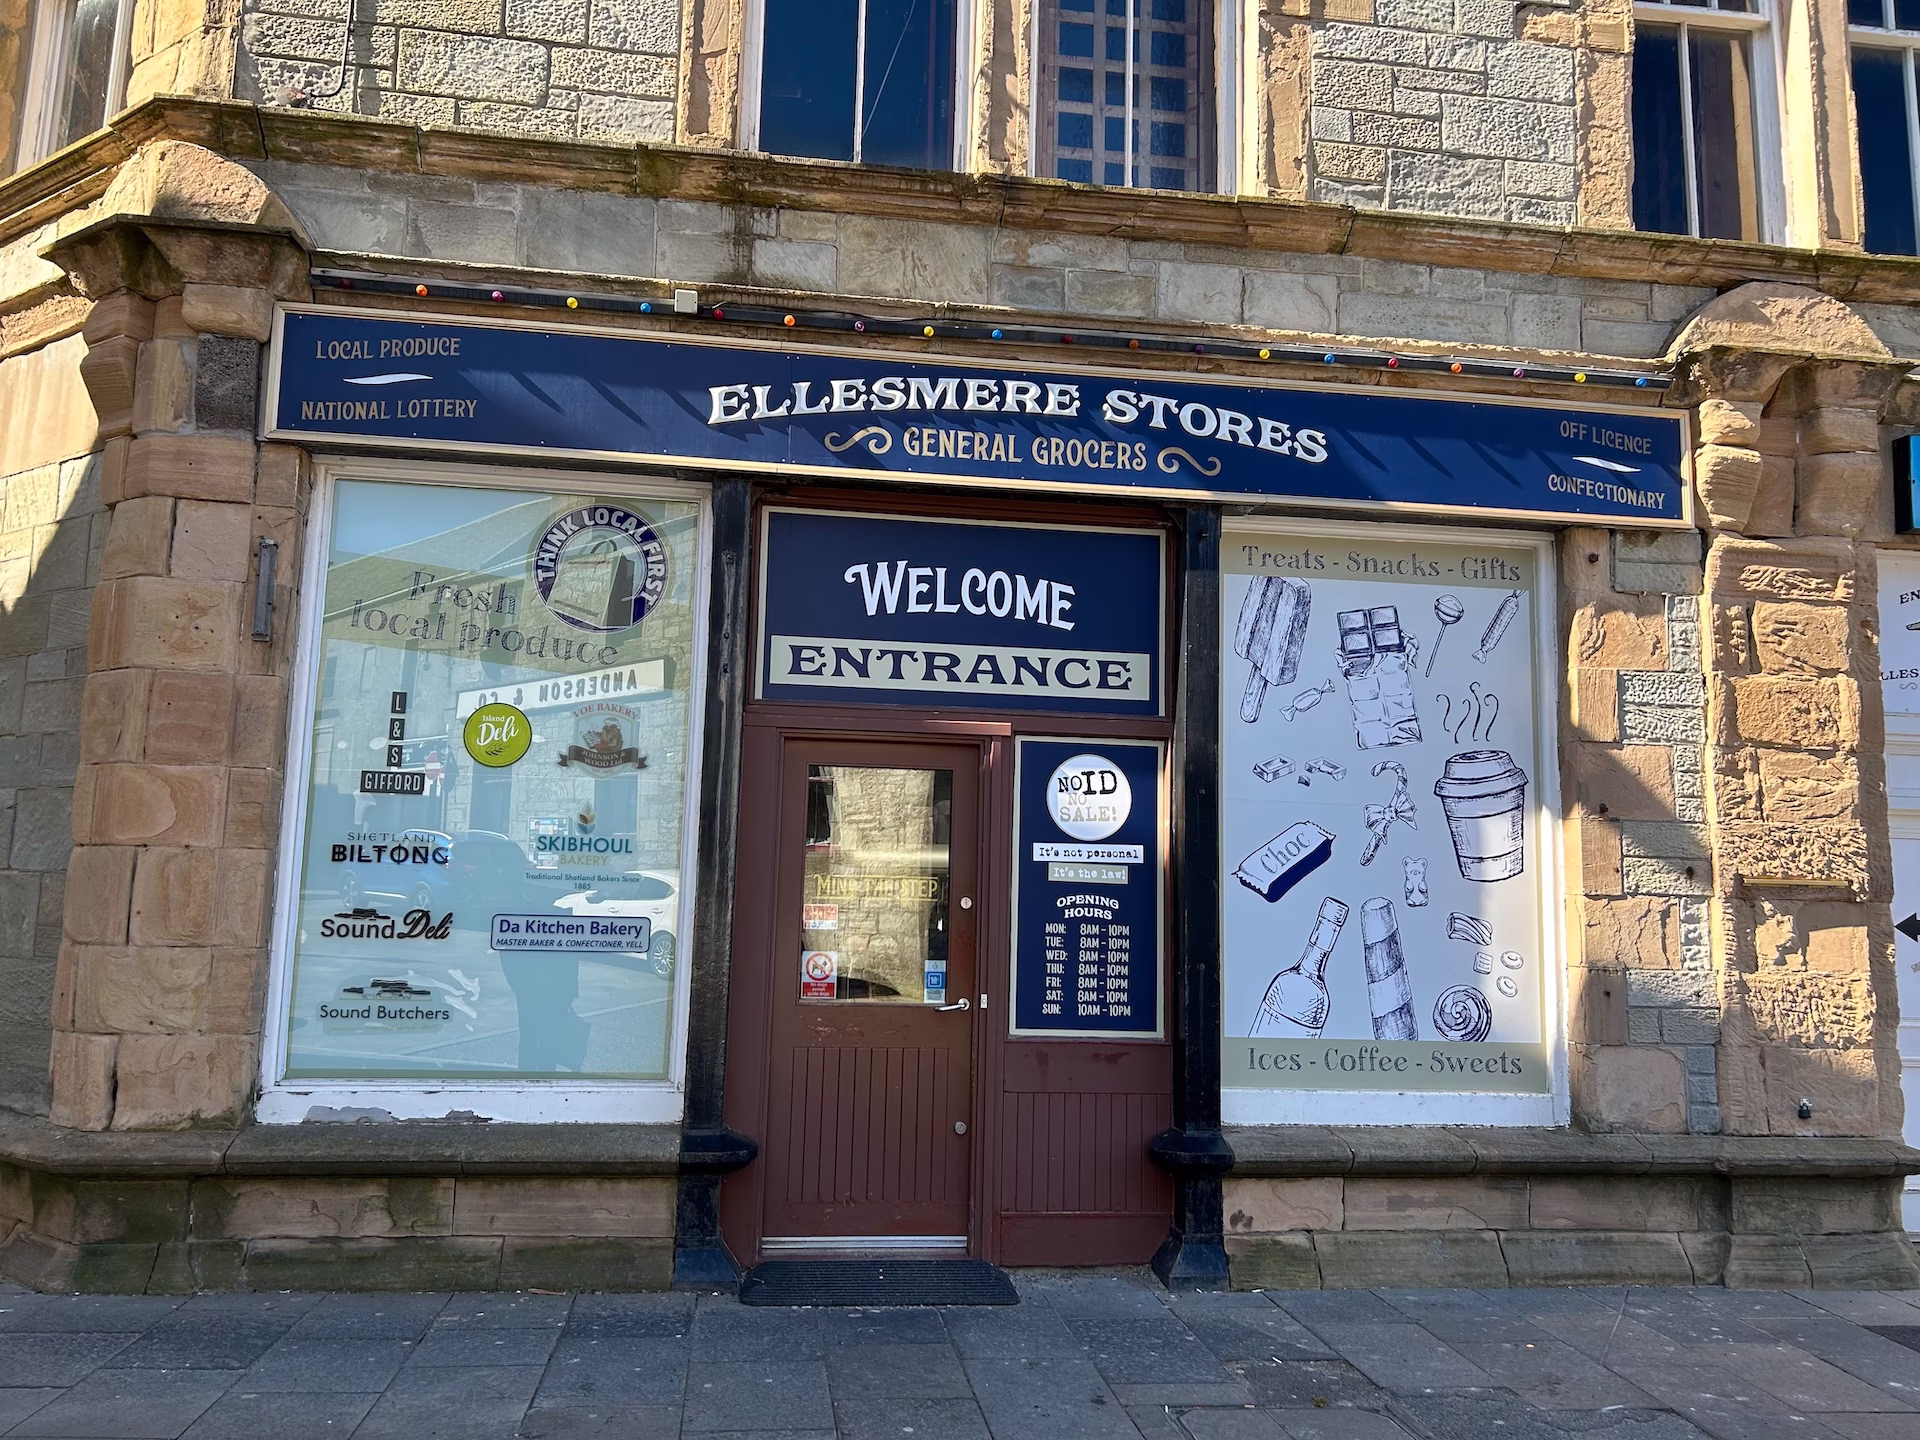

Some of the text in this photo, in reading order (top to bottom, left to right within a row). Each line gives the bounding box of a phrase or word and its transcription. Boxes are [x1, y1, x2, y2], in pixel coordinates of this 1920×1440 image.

[316, 336, 461, 360] LOCAL PRODUCE
[301, 399, 478, 420] NATIONAL LOTTERY
[707, 376, 1330, 465] ELLESMERE STORES
[1560, 420, 1652, 455] OFF LICENCE
[903, 427, 1148, 473] GENERAL GROCERS
[1548, 474, 1665, 510] CONFECTIONARY
[537, 508, 666, 607] THINK LOCAL FIRST
[1242, 545, 1325, 571] Treats
[1346, 550, 1440, 576] Snacks
[1460, 556, 1521, 582] Gifts
[408, 571, 515, 615] Fresh
[844, 560, 1076, 632] WELCOME
[350, 599, 619, 665] local produce
[787, 644, 1133, 691] ENTRANCE
[482, 714, 505, 722] Island
[574, 703, 638, 720] VOE BAKERY
[476, 716, 519, 746] Deli
[582, 750, 619, 761] JOHNSON
[584, 758, 609, 767] WOOD
[364, 772, 421, 792] GIFFORD
[1058, 770, 1118, 795] NO ID
[1068, 793, 1087, 806] NO
[1060, 806, 1117, 822] SALE!
[348, 831, 436, 843] SHETLAND
[536, 836, 633, 854] SKIBHOUL
[560, 854, 610, 866] BAKERY
[1039, 847, 1139, 859] It's not personal
[1260, 832, 1311, 874] Choc
[525, 872, 640, 884] Traditional Shetland Bakers Since
[1054, 867, 1126, 880] It's the law!
[574, 882, 592, 890] 1885
[900, 879, 938, 898] STEP
[1056, 894, 1120, 910] OPENING
[1064, 908, 1113, 920] HOURS
[320, 909, 454, 940] Sound Deli
[499, 920, 643, 938] Da Kitchen Bakery
[1045, 923, 1066, 934] MON:
[1080, 924, 1099, 935] 8AM
[1108, 925, 1129, 936] 10PM
[496, 938, 528, 946] MASTER
[530, 938, 554, 946] BAKER
[566, 939, 624, 948] CONFECTIONER,
[626, 940, 643, 948] YELL
[1045, 936, 1064, 947] TUE:
[1080, 937, 1099, 948] 8AM
[1108, 938, 1129, 949] 10PM
[1046, 950, 1068, 960] WED:
[1079, 950, 1098, 962] 8AM
[1108, 951, 1129, 963] 10PM
[1046, 963, 1064, 974] THU:
[1079, 964, 1098, 975] 8AM
[1107, 965, 1128, 976] 10PM
[1046, 977, 1061, 987] FRI:
[1078, 977, 1097, 988] 8AM
[1107, 978, 1128, 989] 10PM
[1046, 990, 1064, 1001] SAT:
[1078, 991, 1097, 1002] 8AM
[1106, 991, 1127, 1003] 10PM
[320, 1005, 450, 1020] Sound Butchers
[1042, 1003, 1061, 1014] SUN:
[1078, 1004, 1100, 1015] 10AM
[1109, 1005, 1131, 1016] 10PM
[1248, 1047, 1302, 1071] Ices
[1324, 1046, 1408, 1074] Coffee
[1430, 1049, 1522, 1074] Sweets
